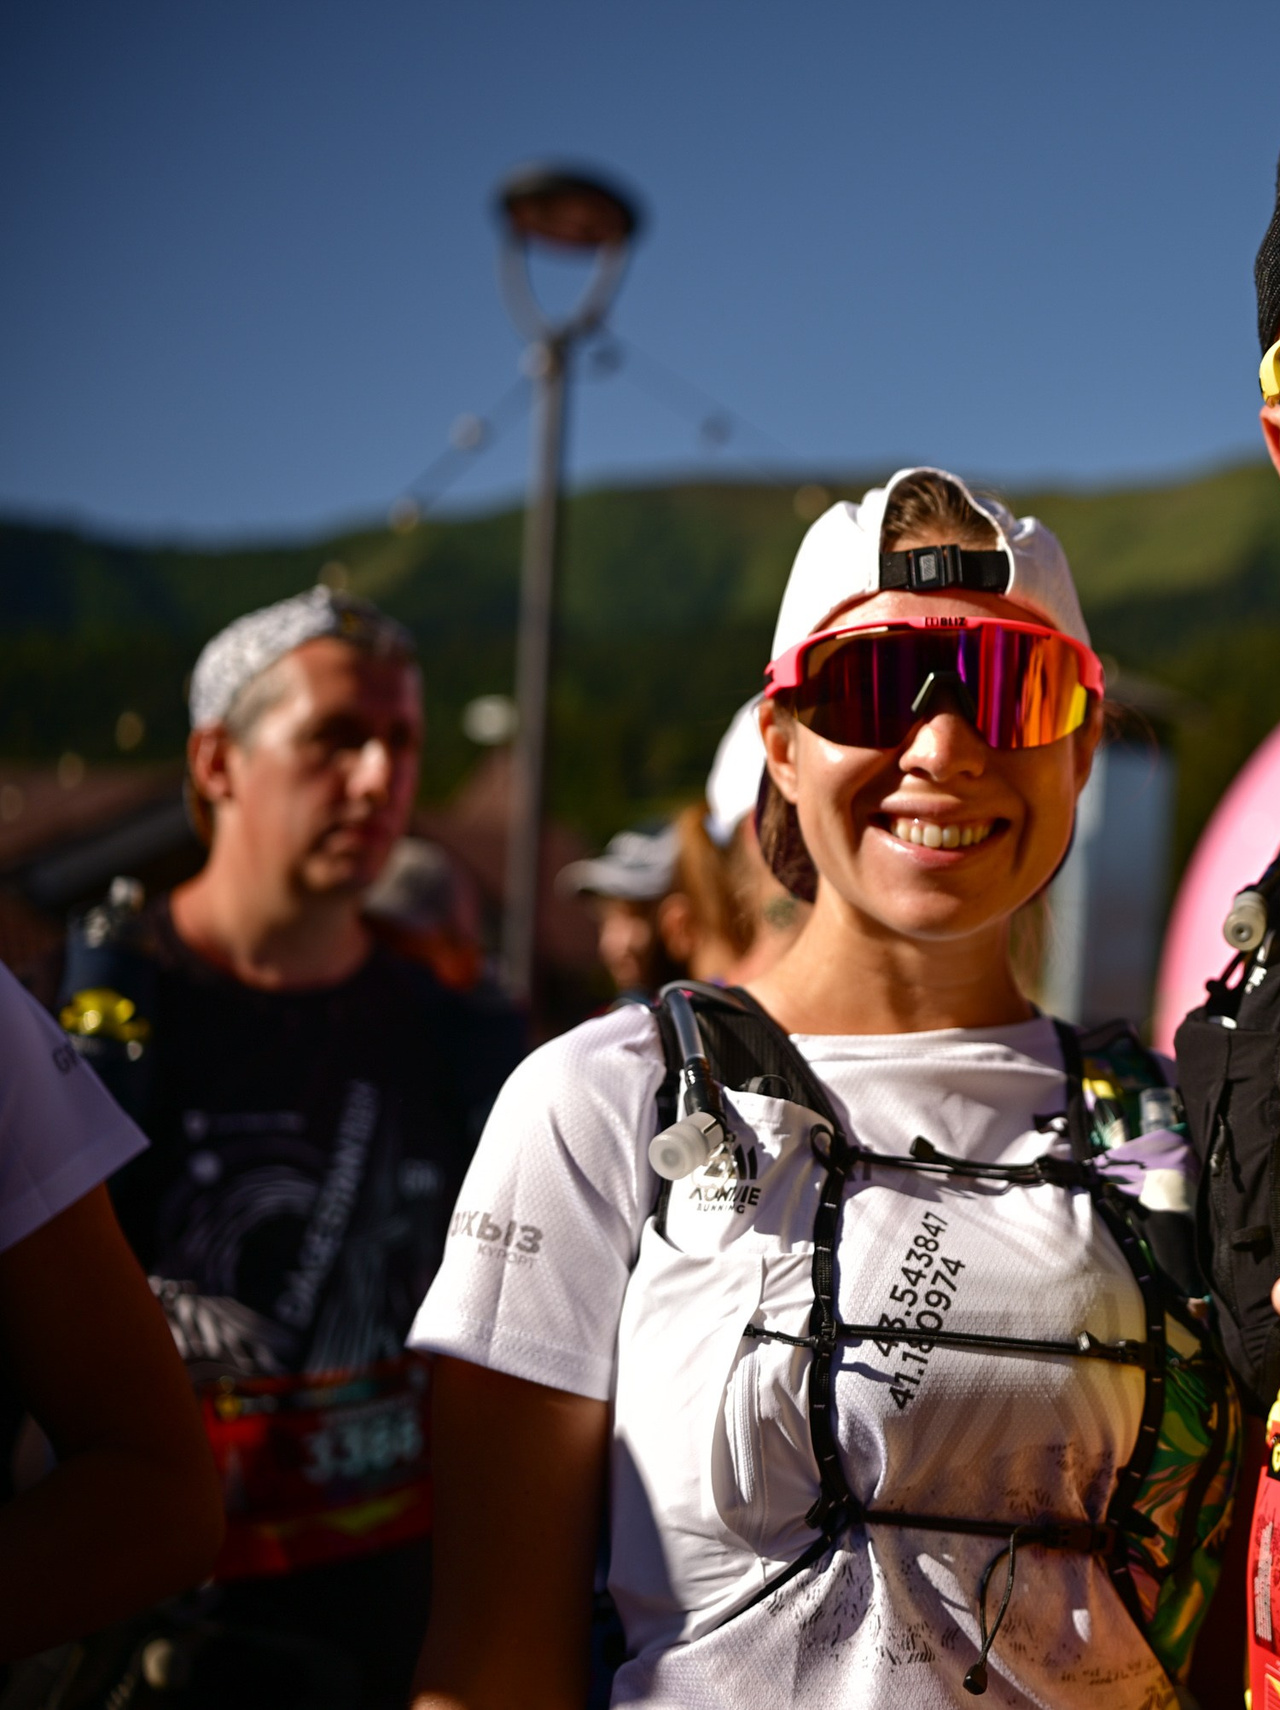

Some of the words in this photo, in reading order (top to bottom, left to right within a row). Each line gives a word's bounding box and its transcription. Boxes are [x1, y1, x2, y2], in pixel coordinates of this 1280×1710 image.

[940, 616, 966, 627] BLIZ
[697, 1203, 745, 1214] RUNNING
[873, 1211, 948, 1357] 43.543847
